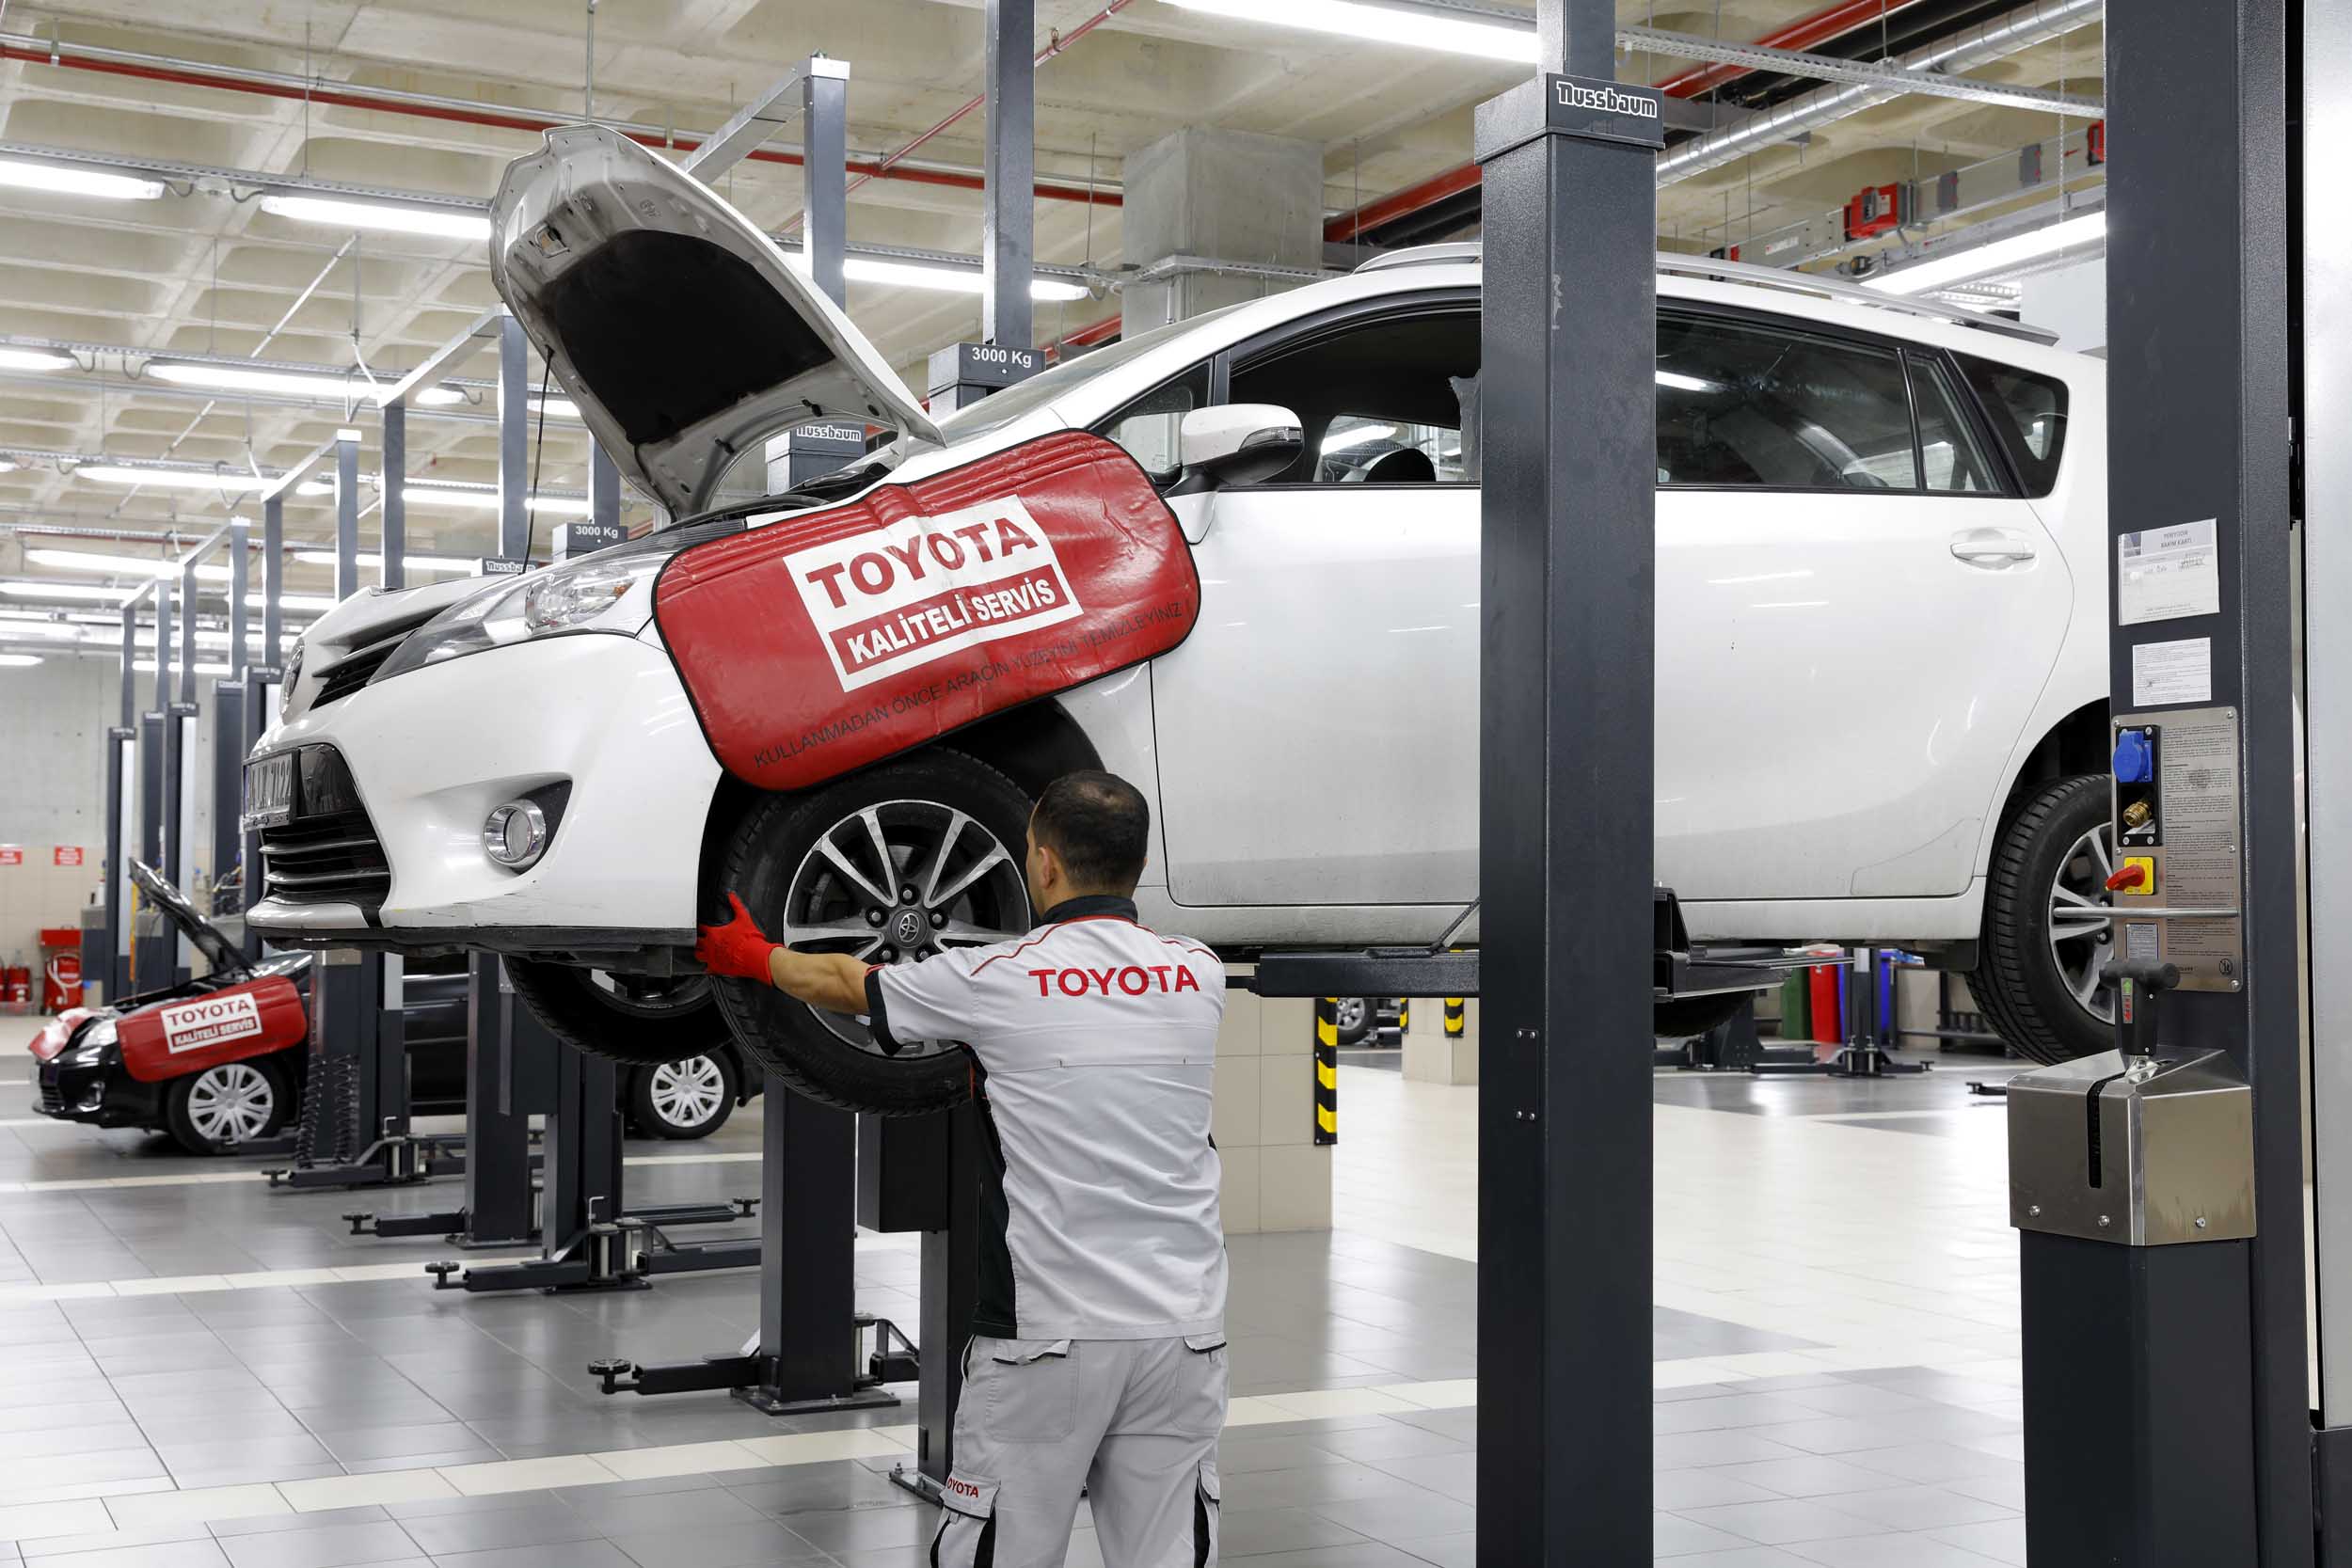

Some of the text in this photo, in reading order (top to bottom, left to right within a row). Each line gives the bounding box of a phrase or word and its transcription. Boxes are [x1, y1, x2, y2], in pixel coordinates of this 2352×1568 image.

[1556, 81, 1657, 118] Nussbaum
[972, 346, 1032, 368] 3000 Kg
[575, 525, 618, 538] 3000 Kg
[485, 561, 535, 573] Nussbam
[805, 516, 1039, 610] TOYOTA
[847, 577, 1056, 664] KALİTELİ SERVİS
[753, 705, 889, 768] KULLANMADAN
[892, 684, 941, 715] ÖNCE
[1028, 964, 1200, 997] TOYOTA
[167, 999, 251, 1026] TOYOTA
[946, 1477, 979, 1498] OYOTA
